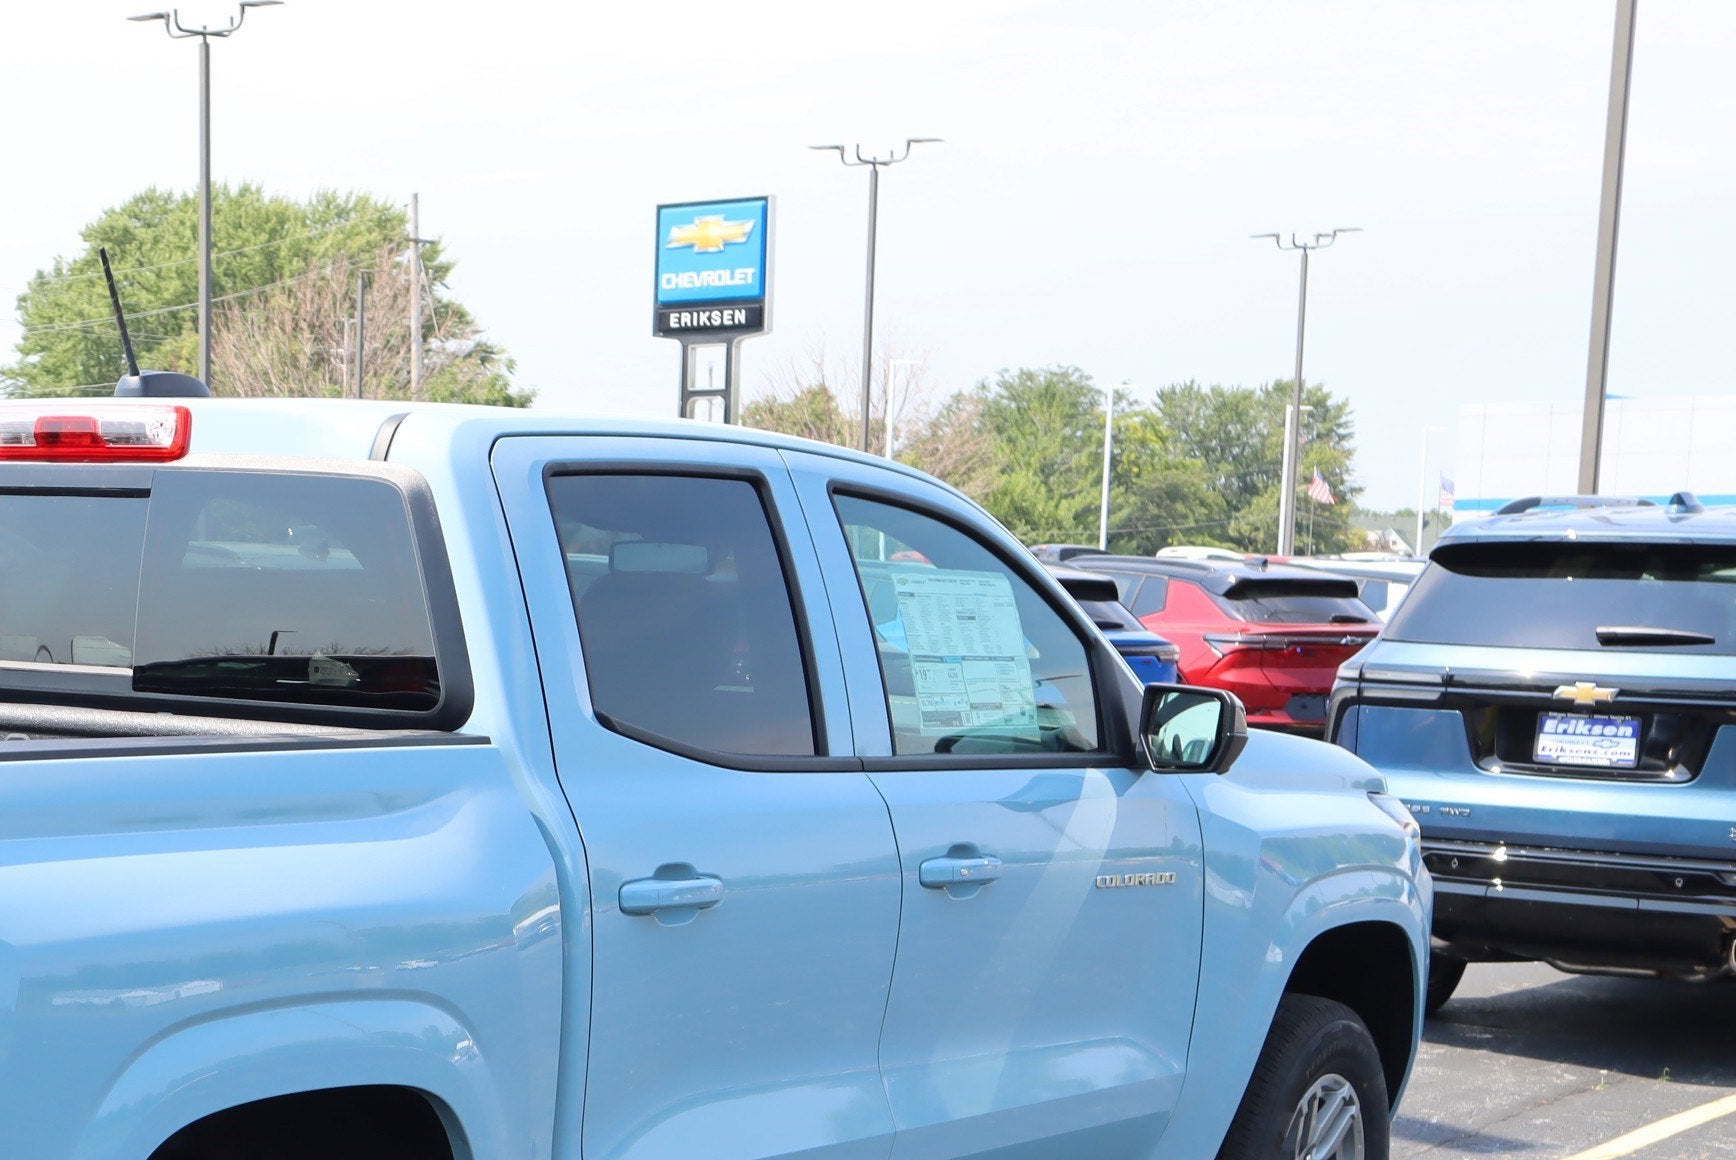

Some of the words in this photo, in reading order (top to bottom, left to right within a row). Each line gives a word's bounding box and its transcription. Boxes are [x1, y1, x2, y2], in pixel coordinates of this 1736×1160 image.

[662, 268, 755, 289] CHEVROLET
[669, 309, 746, 328] ERIKSEN
[1543, 719, 1633, 737] Eriksen
[1096, 871, 1176, 888] COLORADO
